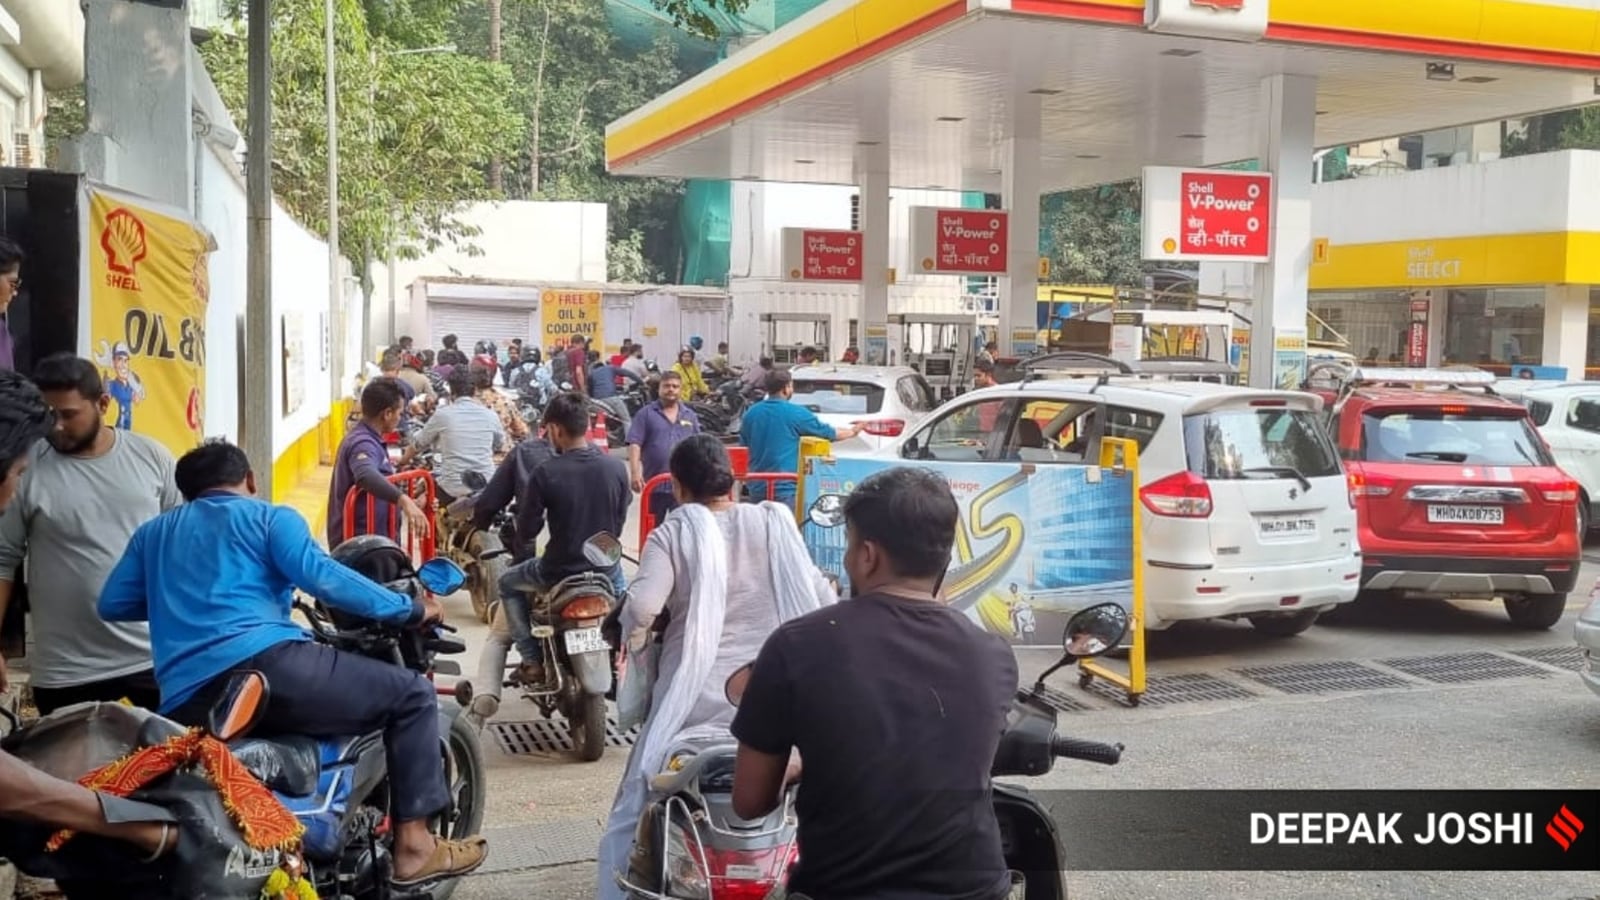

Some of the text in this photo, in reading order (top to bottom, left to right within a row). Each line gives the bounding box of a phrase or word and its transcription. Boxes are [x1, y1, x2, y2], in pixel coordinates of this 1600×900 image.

[1188, 182, 1213, 193] Shell
[1188, 194, 1253, 211] V-Power
[943, 217, 962, 225] Shell
[943, 226, 995, 239] V-Power
[809, 243, 851, 254] V-Power
[1407, 260, 1461, 279] SELECT
[559, 293, 585, 305] FREE
[558, 309, 576, 320] OIL
[125, 309, 174, 358] OIL
[547, 322, 598, 335] COOLANT
